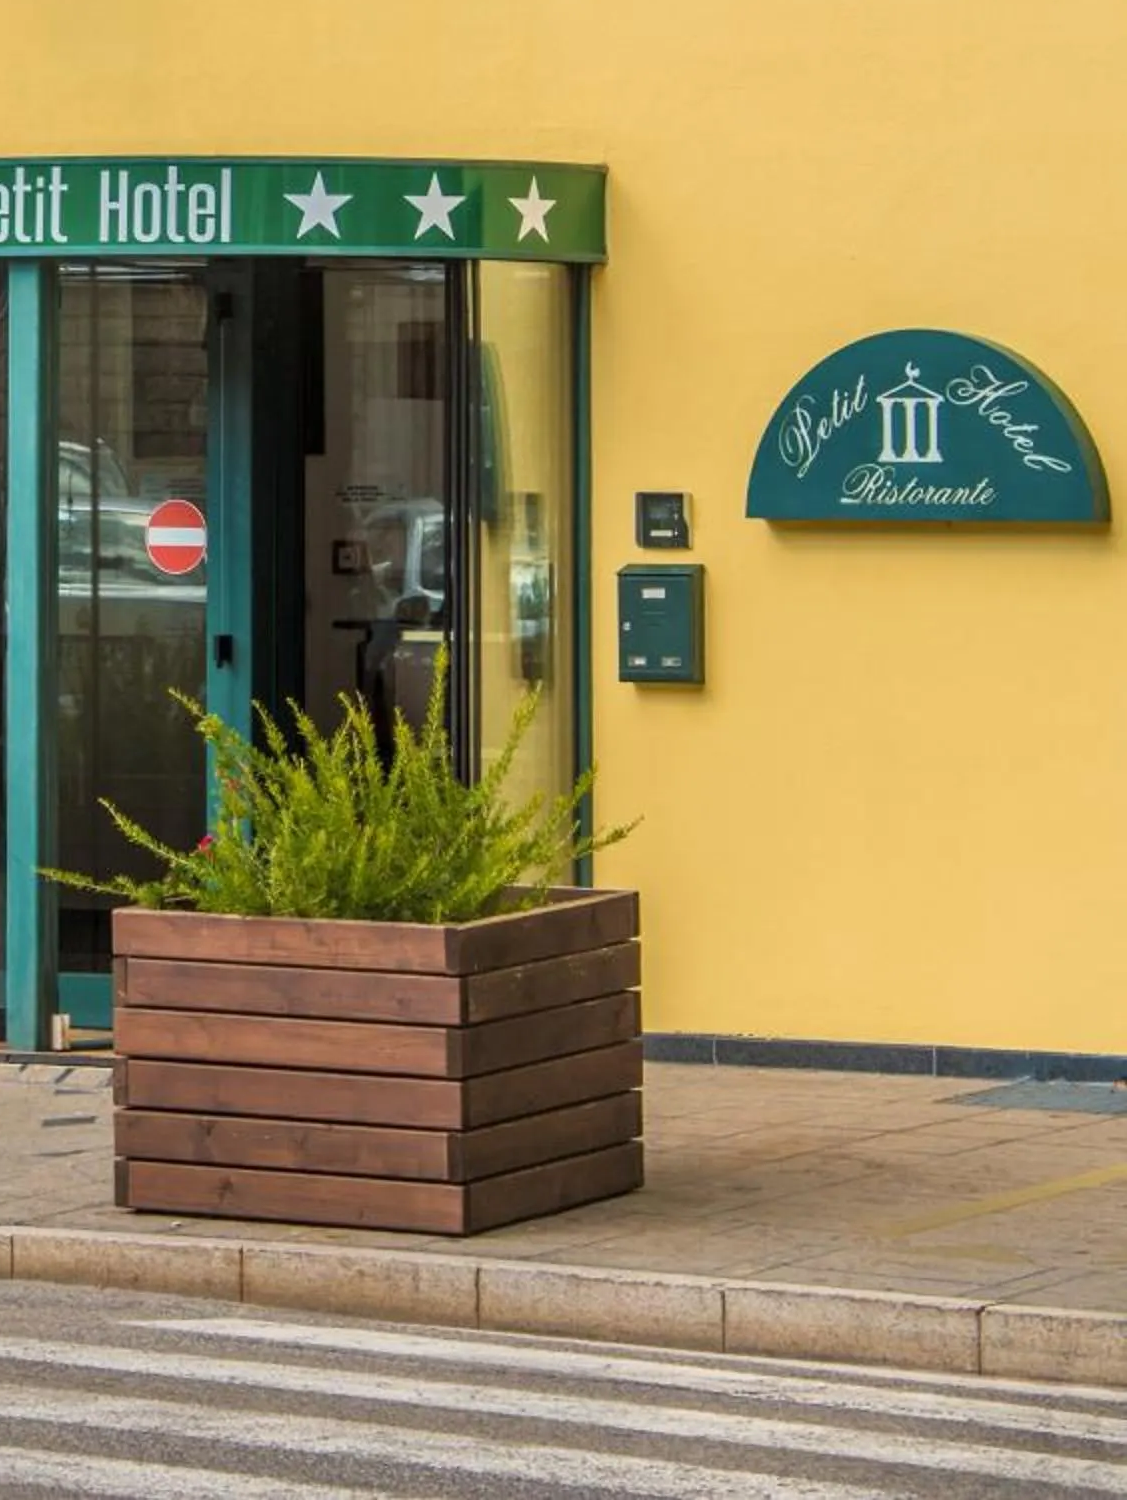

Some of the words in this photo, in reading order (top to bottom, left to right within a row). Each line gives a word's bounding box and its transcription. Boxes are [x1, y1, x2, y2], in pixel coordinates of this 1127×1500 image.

[99, 165, 232, 243] Hotel
[778, 374, 869, 478] Petit
[946, 365, 1072, 474] Hotel
[840, 463, 996, 505] Ristorante
